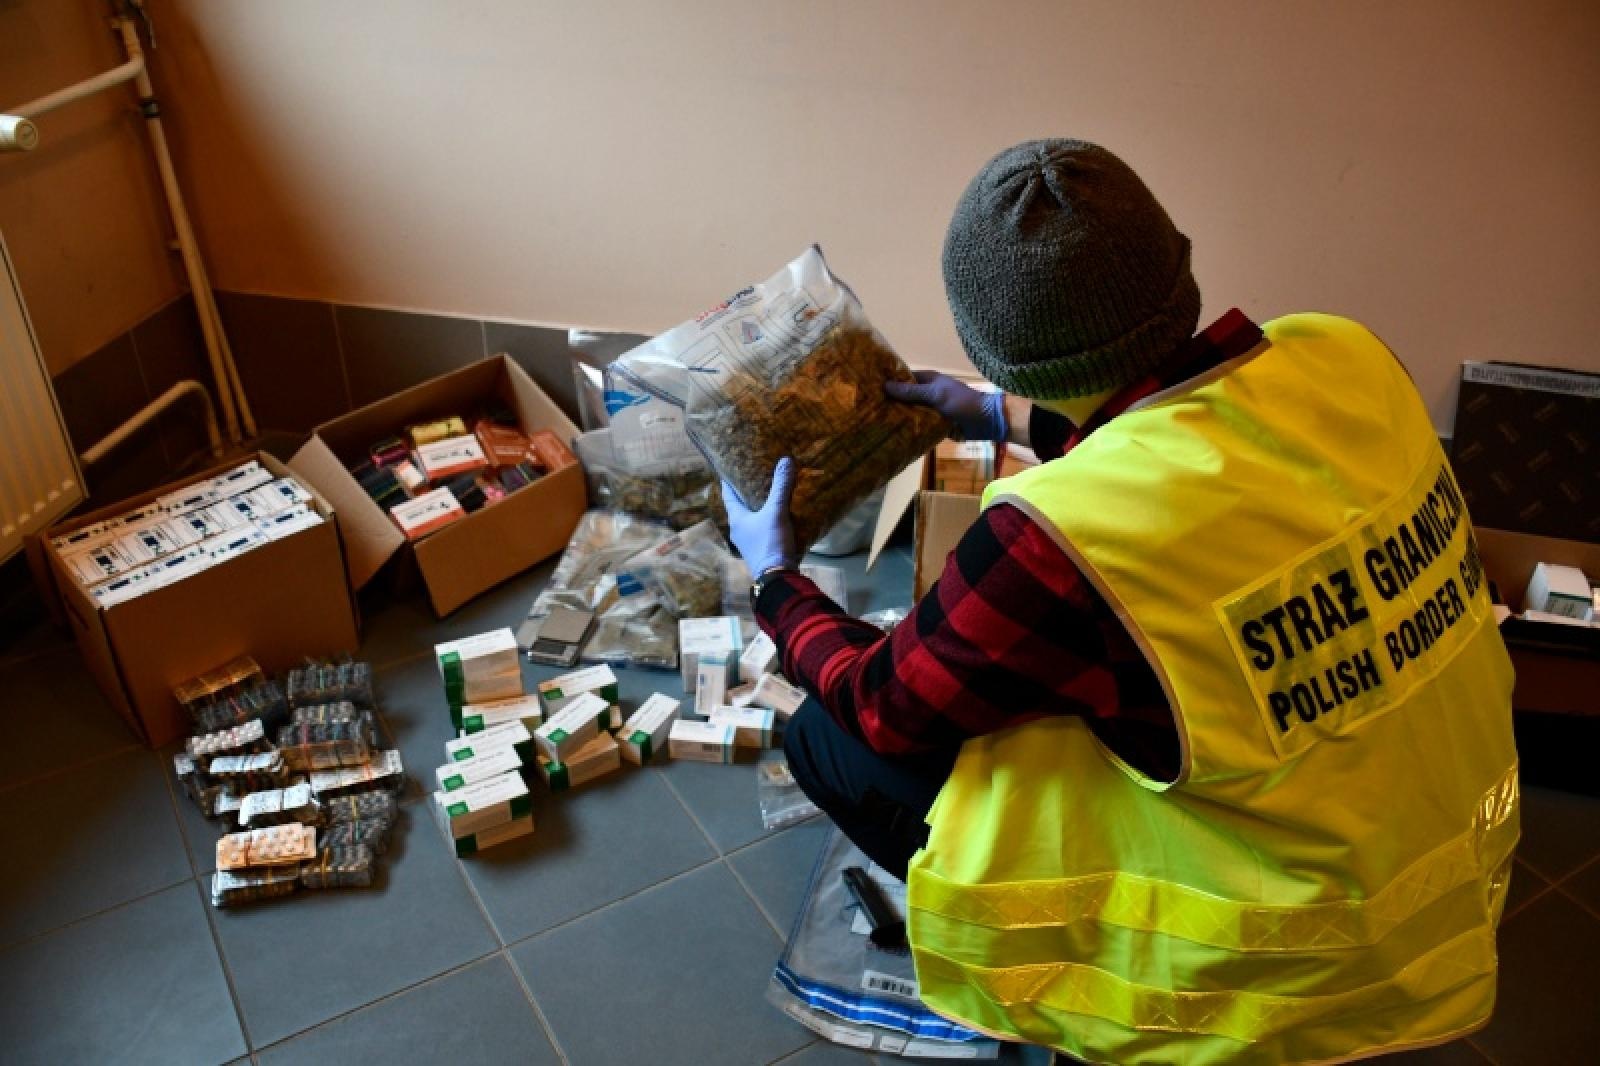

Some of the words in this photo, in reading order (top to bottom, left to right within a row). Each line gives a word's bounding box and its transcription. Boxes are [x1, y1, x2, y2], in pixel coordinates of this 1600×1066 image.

[1364, 464, 1463, 601] GRANICZN
[1268, 648, 1382, 732] POLISH
[1384, 578, 1466, 672] BORDER
